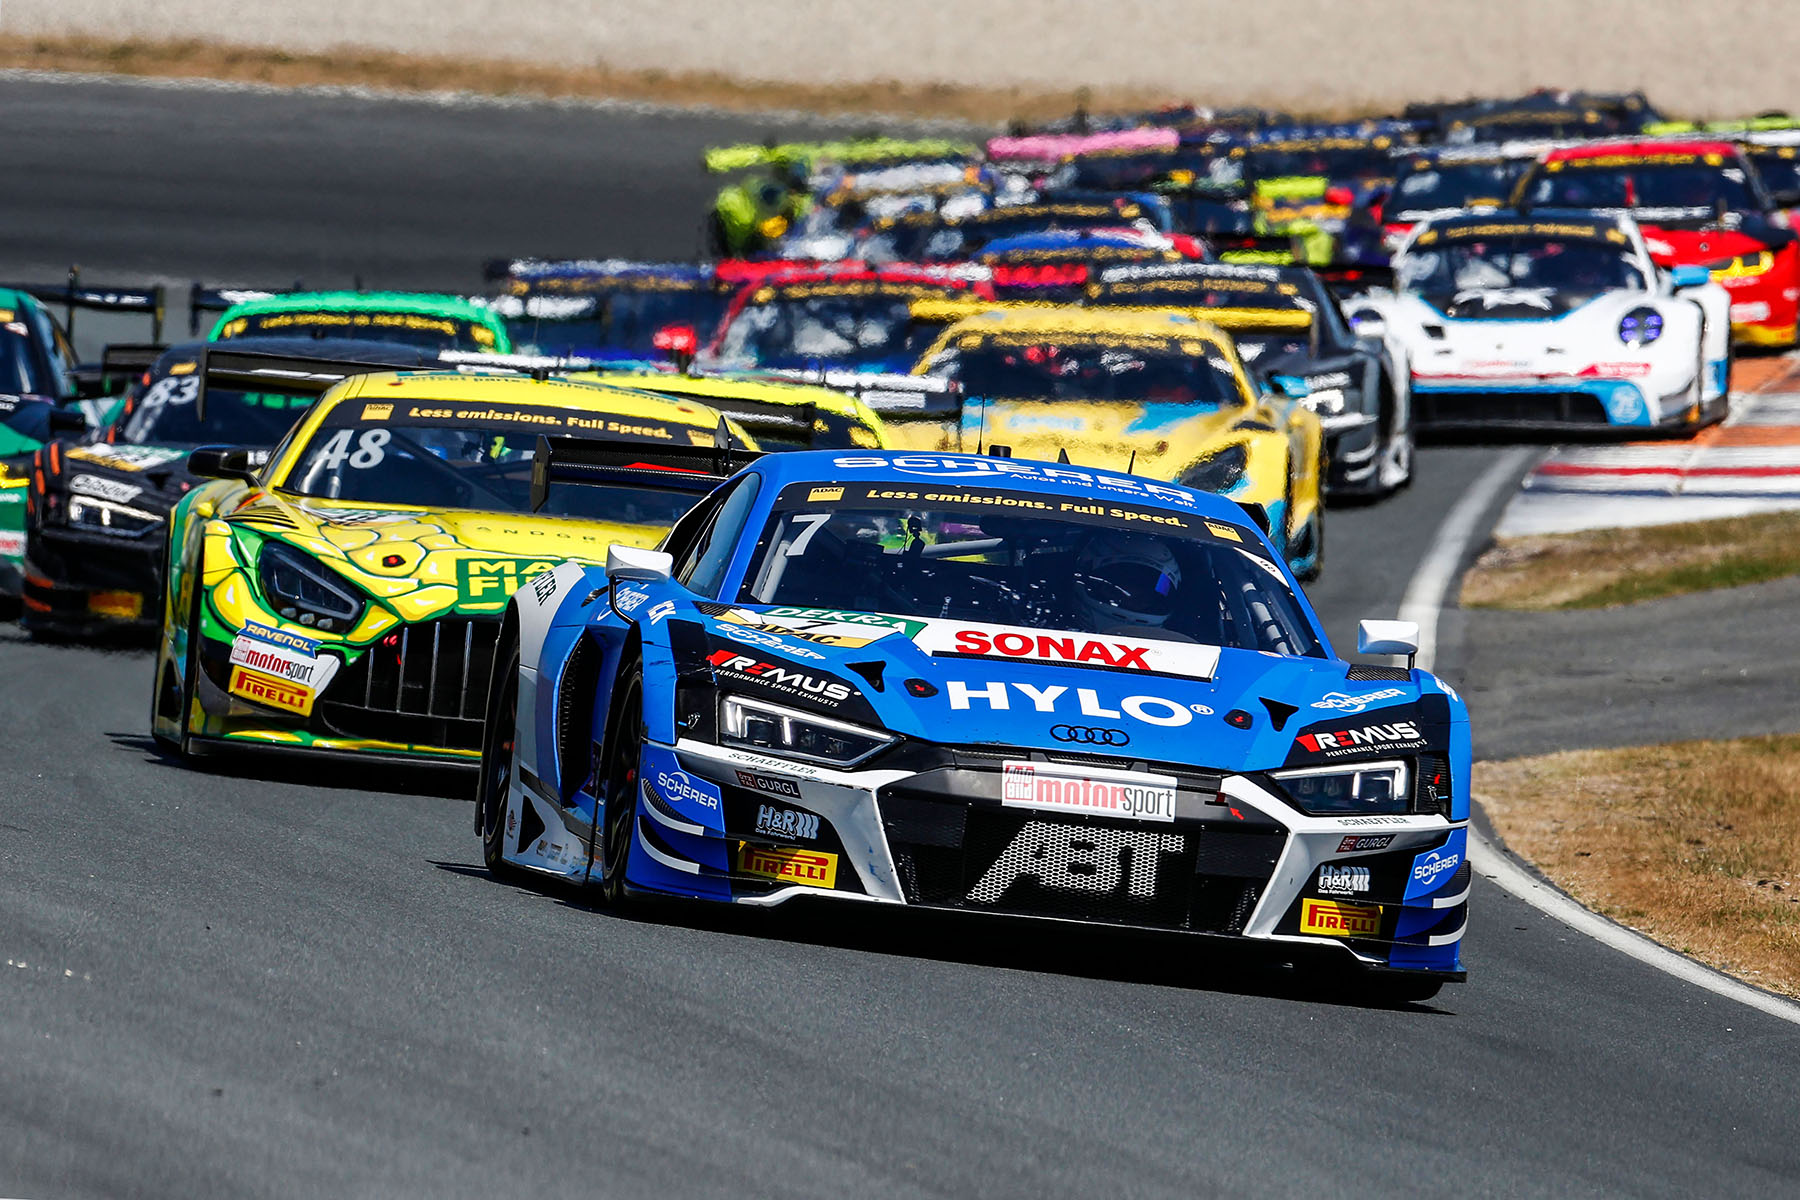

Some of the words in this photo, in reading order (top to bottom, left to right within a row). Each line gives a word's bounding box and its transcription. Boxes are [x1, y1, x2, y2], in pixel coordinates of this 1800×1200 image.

[408, 407, 453, 418] Less
[456, 409, 562, 425] emissions.
[567, 416, 604, 430] Full
[607, 422, 673, 440] Speed.
[308, 428, 391, 470] 48
[812, 486, 843, 494] ADAC
[833, 457, 1196, 502] SCHERER
[1010, 473, 1056, 483] Autos
[1061, 479, 1092, 488] sind
[1097, 485, 1150, 498] unsere
[1154, 494, 1198, 509] Welt.
[866, 489, 919, 500] Less
[924, 493, 1054, 511] emissions.
[1060, 503, 1105, 516] Full
[1110, 508, 1189, 528] Speed.
[785, 513, 832, 557] 7
[246, 624, 311, 652] RAVENOL
[768, 607, 909, 635] DEKRA
[716, 623, 826, 660] SCHERER
[955, 630, 1152, 670] SONAX
[246, 649, 315, 683] motorsport
[722, 655, 851, 701] REMUS
[236, 671, 308, 709] PIRELLI
[714, 669, 770, 686] PERFORMANCE
[771, 682, 798, 694] SPORT
[798, 691, 840, 708] EXHAUSTS
[1310, 688, 1407, 709] SCHERER
[1314, 722, 1421, 749] REMUS
[728, 753, 817, 775] SCHAEFFLER
[657, 771, 718, 811] SCHERER
[757, 778, 799, 796] GURGL
[1037, 778, 1174, 817] motorsport
[757, 804, 798, 836] H&R
[1356, 837, 1391, 849] GURGL
[744, 847, 829, 881] PIRELLI
[966, 820, 1185, 903] ABT
[1318, 864, 1353, 891] H&R
[1414, 853, 1459, 880] SCHERER
[1308, 904, 1377, 933] PIRELLI
